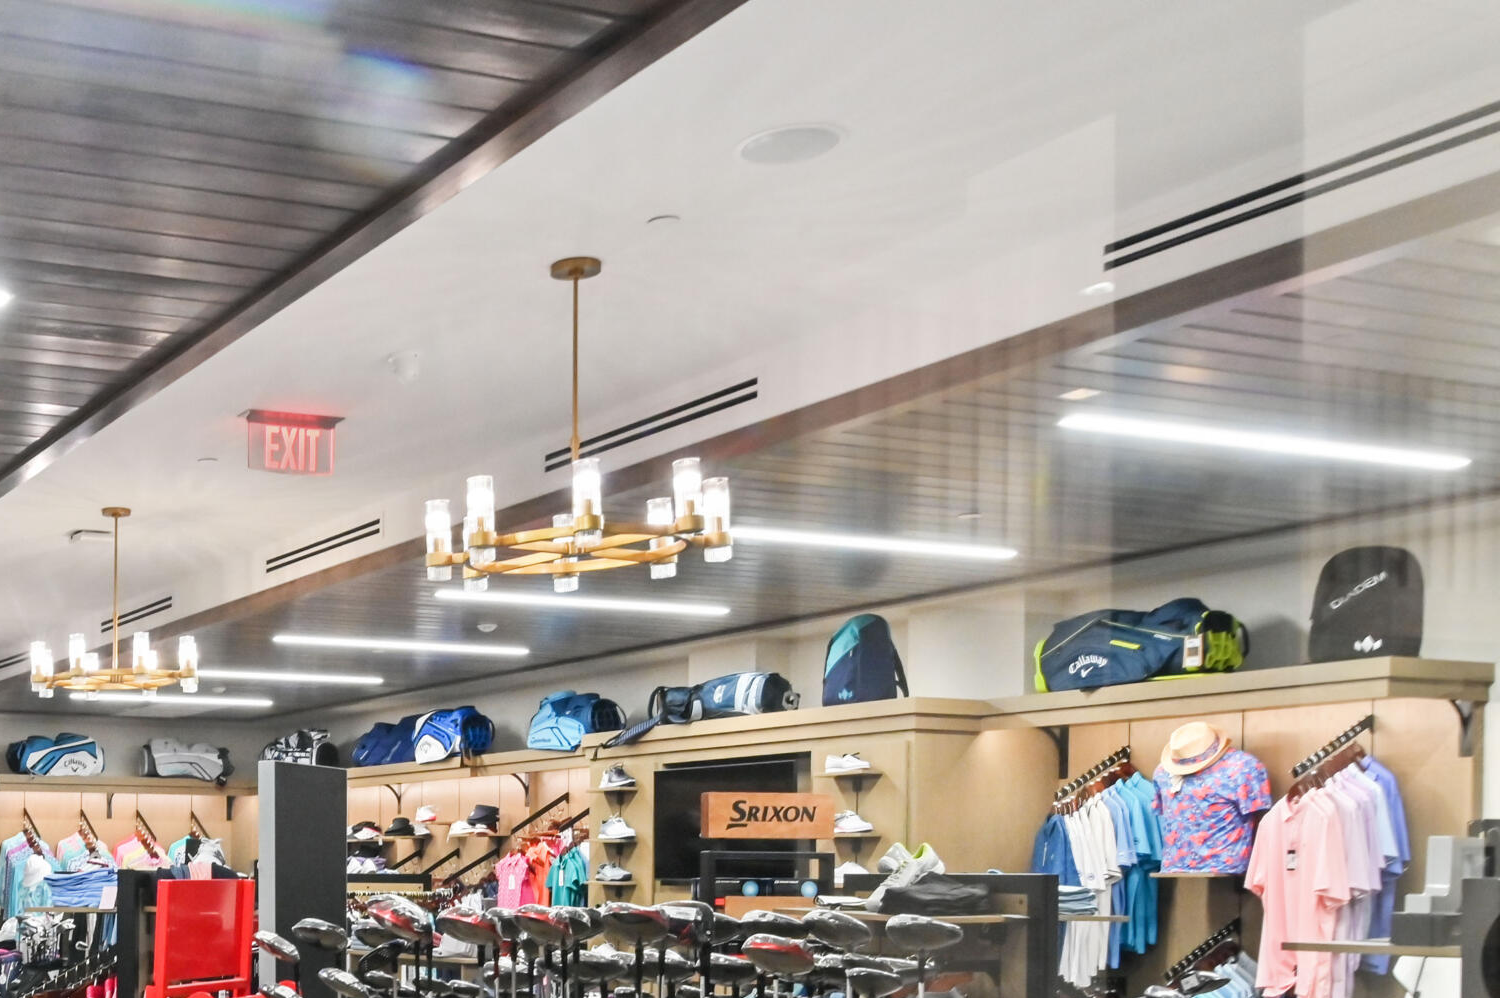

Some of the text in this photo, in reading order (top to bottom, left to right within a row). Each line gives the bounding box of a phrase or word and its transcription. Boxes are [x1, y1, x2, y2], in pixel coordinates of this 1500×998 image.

[264, 424, 321, 474] EXIT
[1068, 653, 1109, 675] Callaway
[63, 757, 88, 769] Callaway
[727, 799, 817, 825] SRIXON
